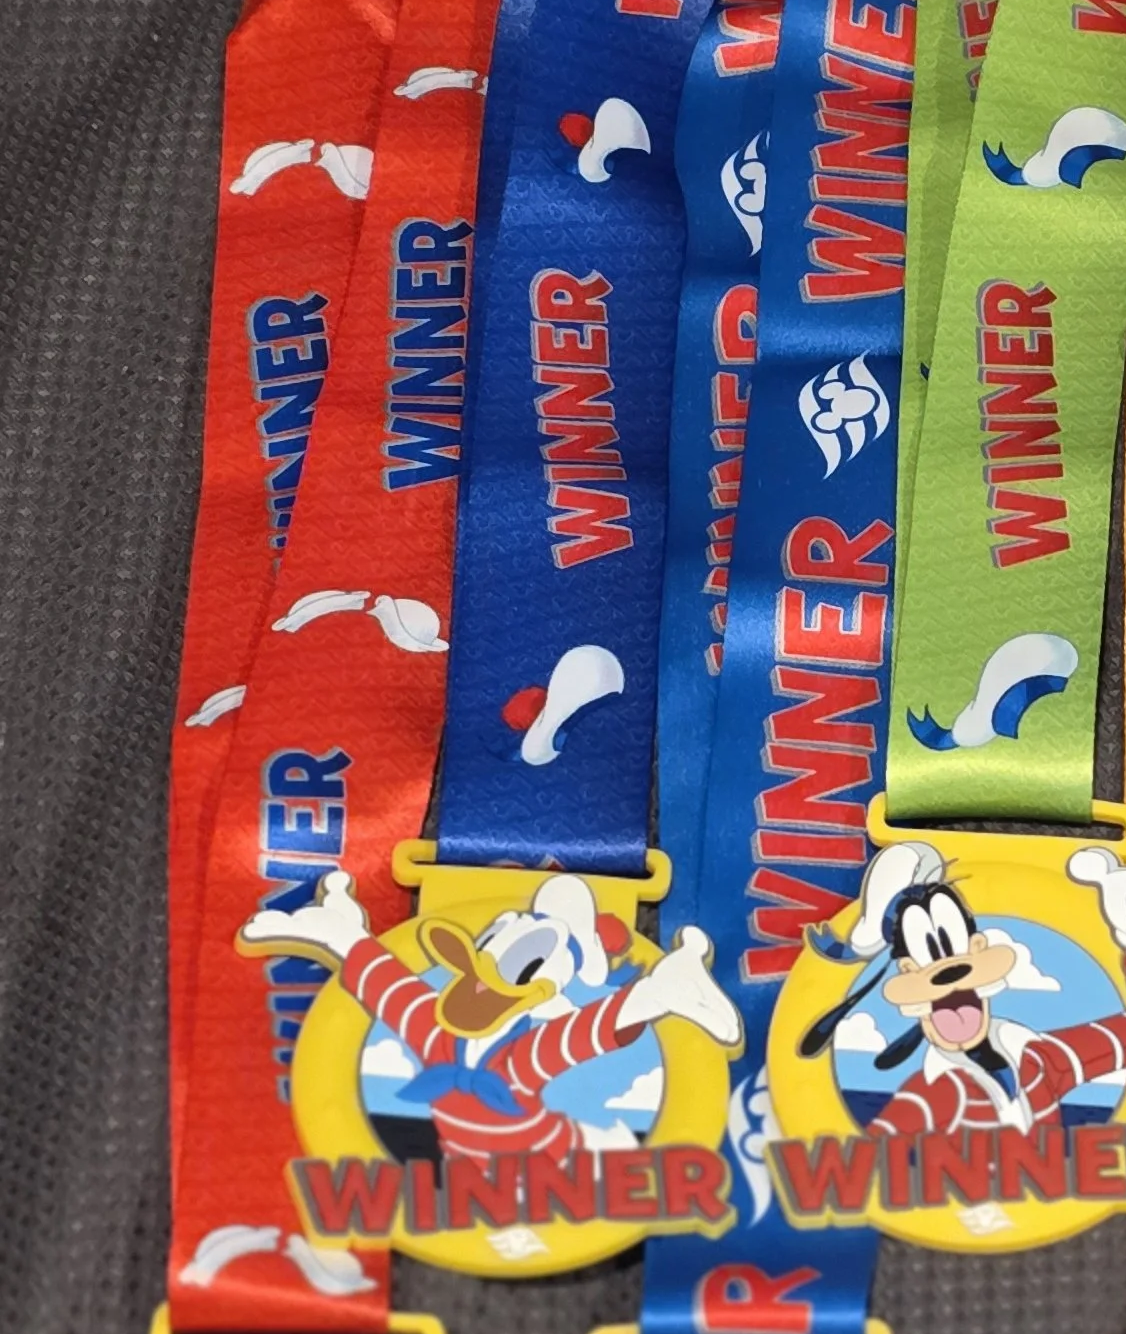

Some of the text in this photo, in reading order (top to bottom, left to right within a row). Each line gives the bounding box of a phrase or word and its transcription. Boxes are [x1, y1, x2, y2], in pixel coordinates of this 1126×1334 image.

[381, 217, 475, 493] WINNER
[529, 267, 636, 569] WINNER
[976, 278, 1071, 569] WINNER
[740, 515, 895, 984] WINNER
[293, 1144, 732, 1238] WINNER
